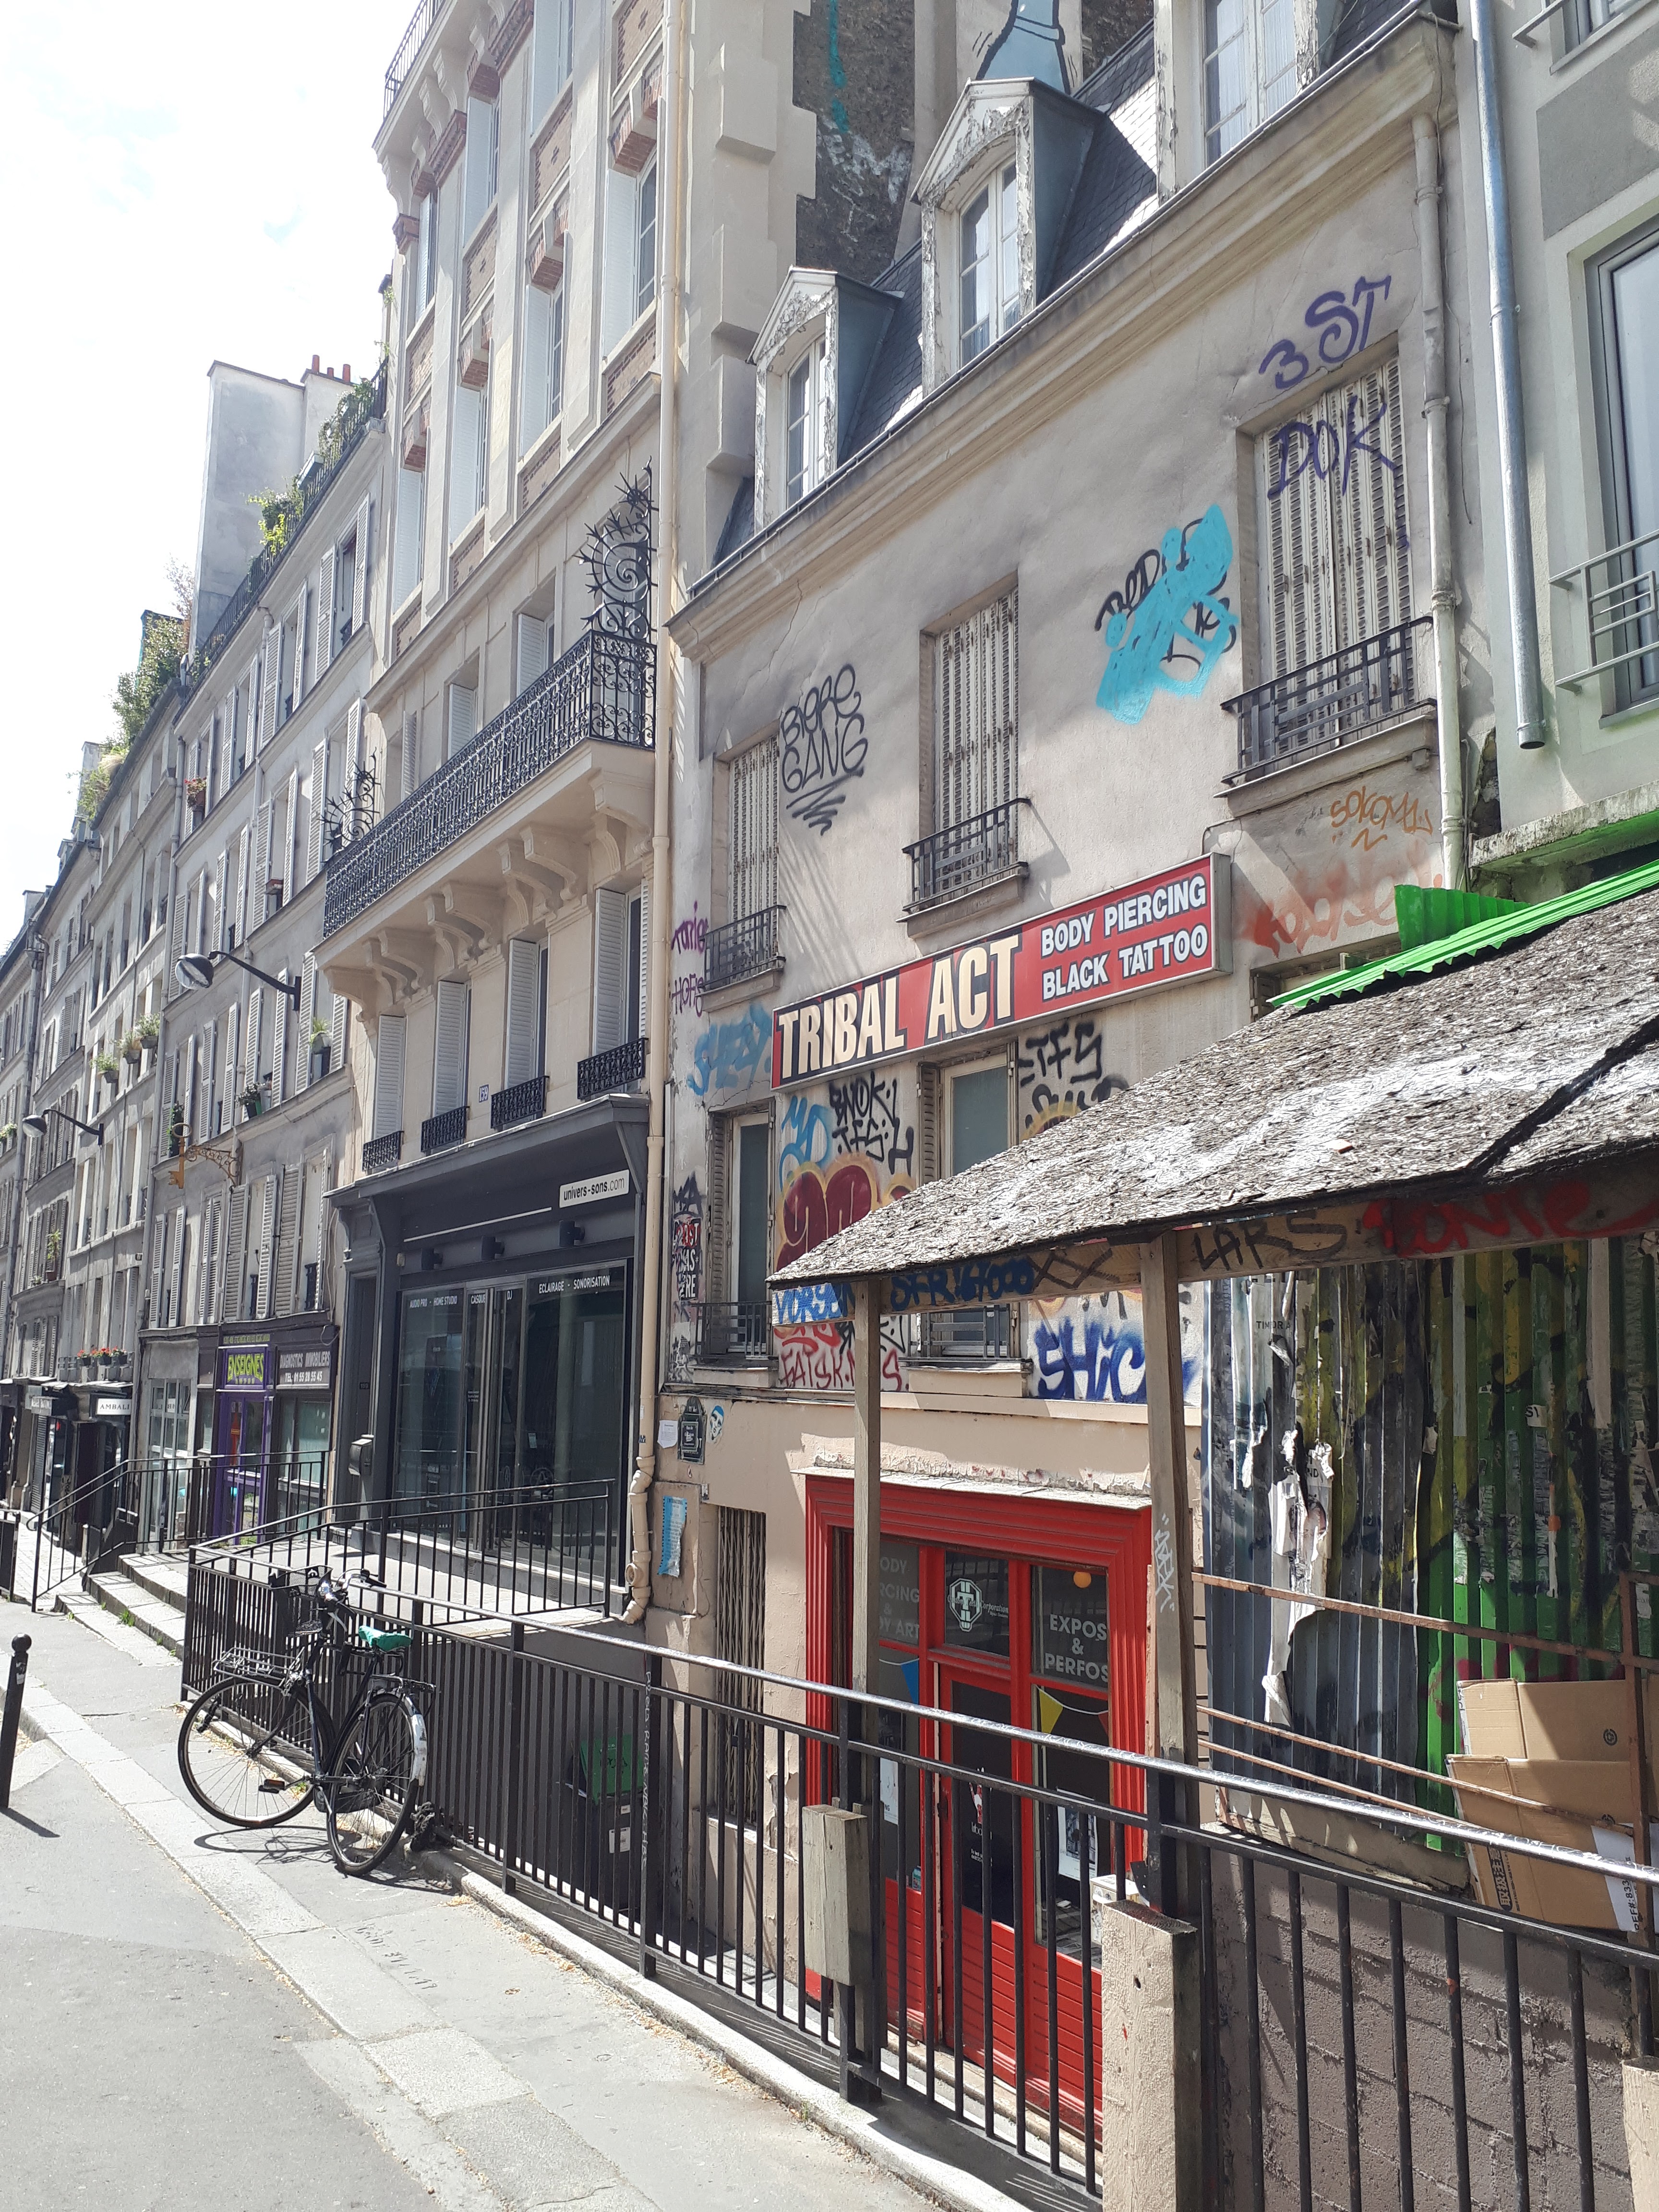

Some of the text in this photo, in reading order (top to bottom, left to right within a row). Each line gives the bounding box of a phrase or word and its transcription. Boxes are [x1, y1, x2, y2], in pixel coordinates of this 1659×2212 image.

[782, 713, 868, 793] GANG
[1041, 912, 1095, 957] BODY
[1104, 875, 1206, 937] PIERCING
[1043, 925, 1208, 1000] BLACK TATTOO
[778, 976, 905, 1080] TRIBAL
[926, 934, 1019, 1040] ACT
[479, 1086, 488, 1102] 159
[564, 1178, 625, 1201] univers-sons.com
[539, 1275, 610, 1294] ECLAIRAGE SONORISATION
[409, 1300, 420, 1309] AUDIO
[433, 1297, 444, 1306] HOME
[444, 1296, 457, 1306] STUDIO
[507, 1290, 513, 1300] DJ
[227, 1353, 264, 1382] ENSEIGNES
[279, 1351, 331, 1369] DIAGNOSTICS IMMOBILIERS
[294, 1372, 299, 1382] 01
[299, 1372, 304, 1382] 55
[305, 1371, 310, 1382] 28
[311, 1371, 316, 1381] 55
[317, 1371, 323, 1381] 45
[879, 1556, 907, 1574] ODY
[980, 1600, 1009, 1613] Corporation
[1050, 1613, 1107, 1641] EXPOS
[1071, 1637, 1084, 1655] &
